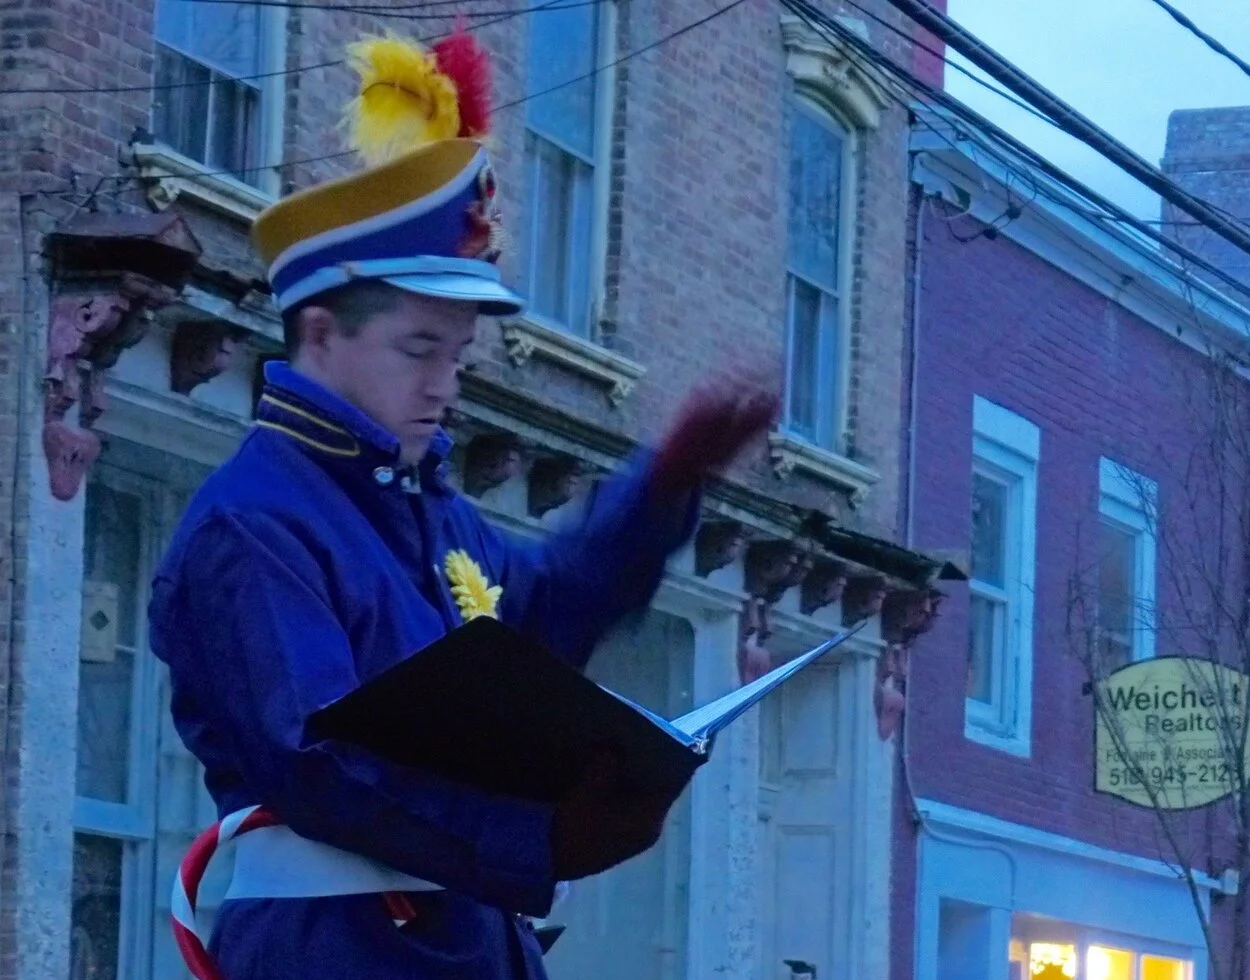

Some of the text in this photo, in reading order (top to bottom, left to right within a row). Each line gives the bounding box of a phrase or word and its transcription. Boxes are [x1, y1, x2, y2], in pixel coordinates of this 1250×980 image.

[1108, 684, 1241, 711] Weichet
[1145, 713, 1241, 733] Realtos
[1151, 764, 1238, 784] 945-212
